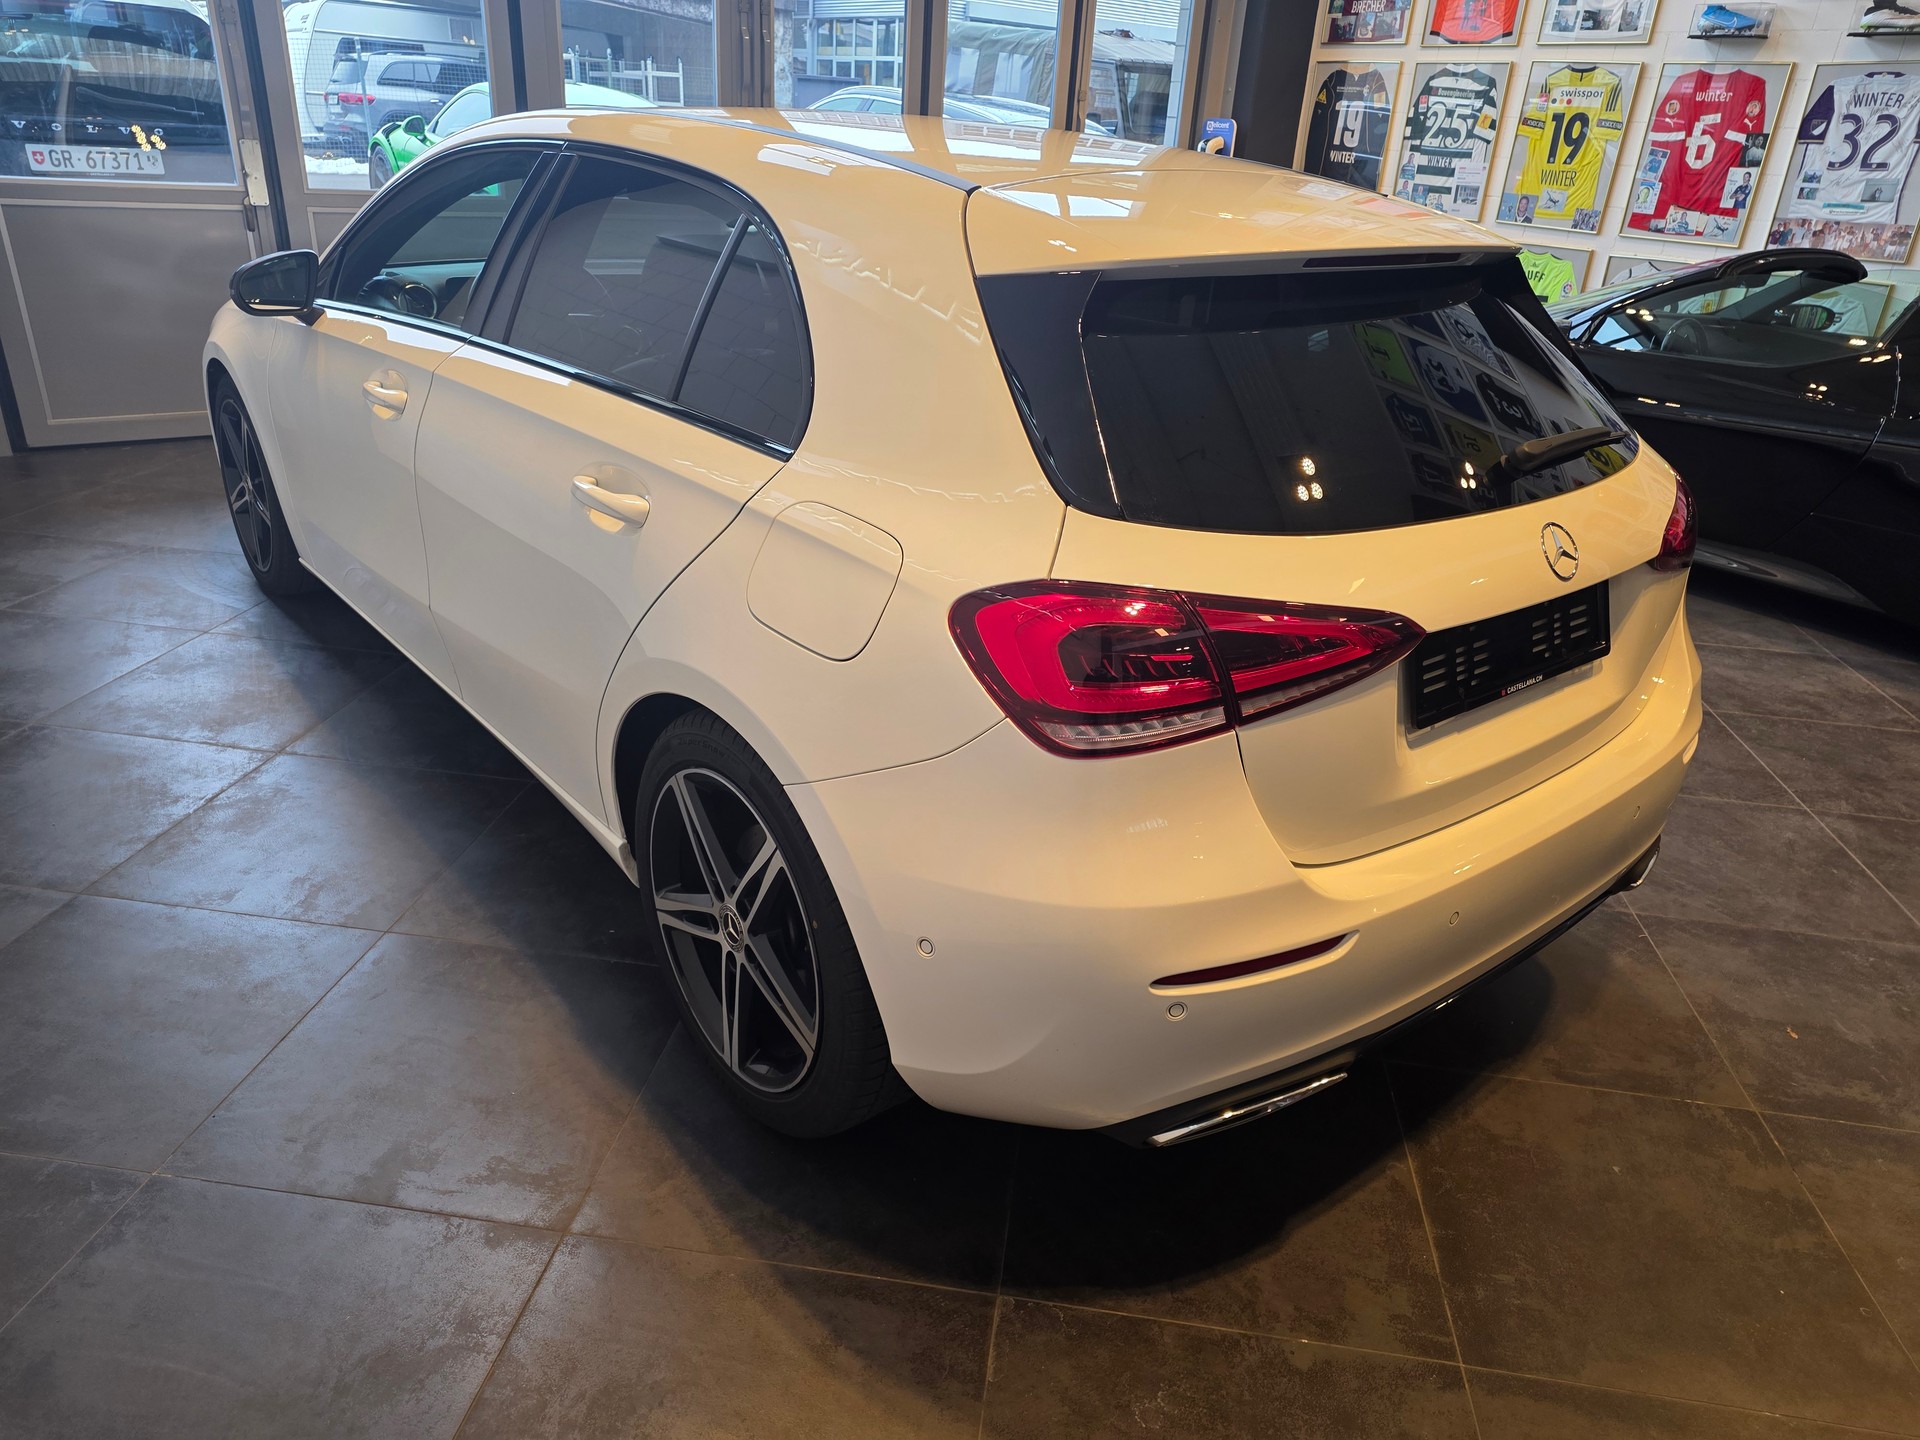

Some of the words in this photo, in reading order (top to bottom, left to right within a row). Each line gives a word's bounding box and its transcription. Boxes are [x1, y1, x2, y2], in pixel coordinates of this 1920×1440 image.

[1351, 0, 1387, 13] BRECHER
[1560, 88, 1604, 99] swisspor
[1695, 90, 1734, 102] winter
[1852, 92, 1905, 108] WINTER
[11, 120, 164, 136] VOLVO
[1333, 100, 1366, 148] 19
[1420, 101, 1468, 149] 25
[1546, 112, 1590, 165] 19
[1685, 113, 1722, 169] 6
[1826, 113, 1901, 171] 32
[1427, 155, 1453, 168] WINTER
[1540, 168, 1577, 187] WINTER
[1507, 674, 1543, 694] CASTELLANA.CH
